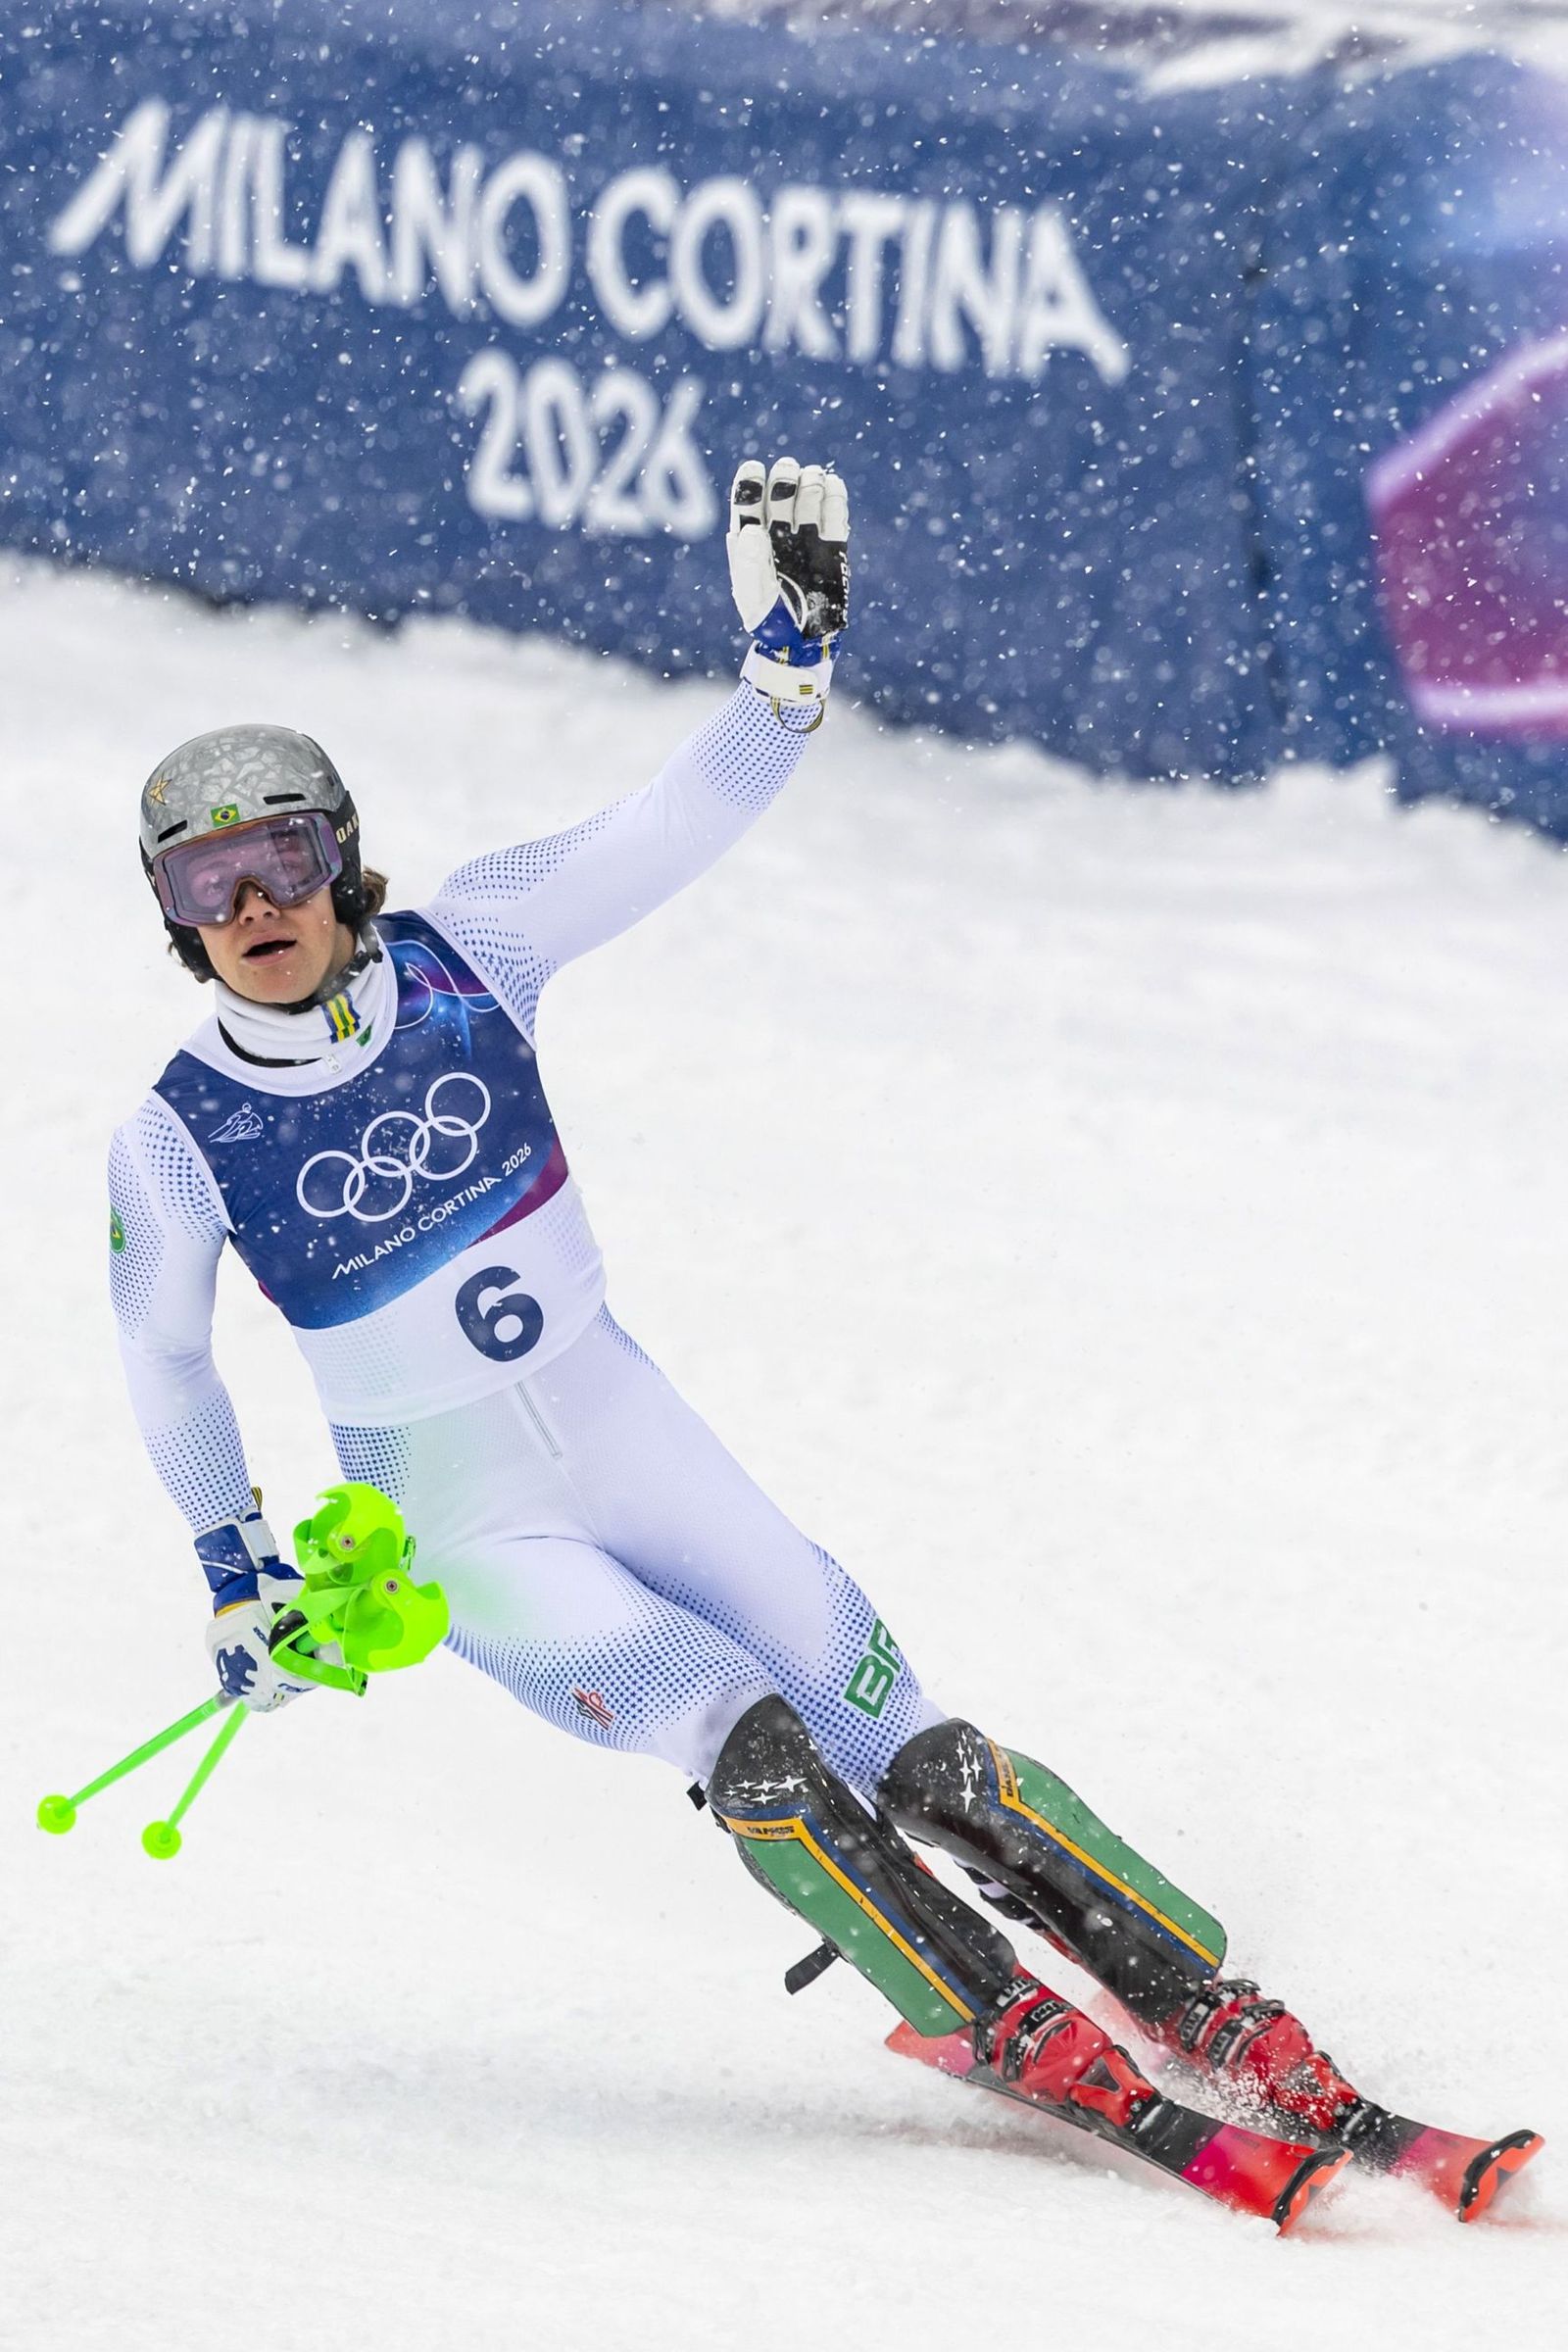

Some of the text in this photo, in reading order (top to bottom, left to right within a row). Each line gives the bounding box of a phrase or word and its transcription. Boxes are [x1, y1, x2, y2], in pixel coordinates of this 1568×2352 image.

[48, 97, 1131, 384] MILANO CORTINA
[460, 346, 716, 540] 2026
[332, 1143, 532, 1280] MILANO CORTINA 2026
[455, 1265, 544, 1362] 6
